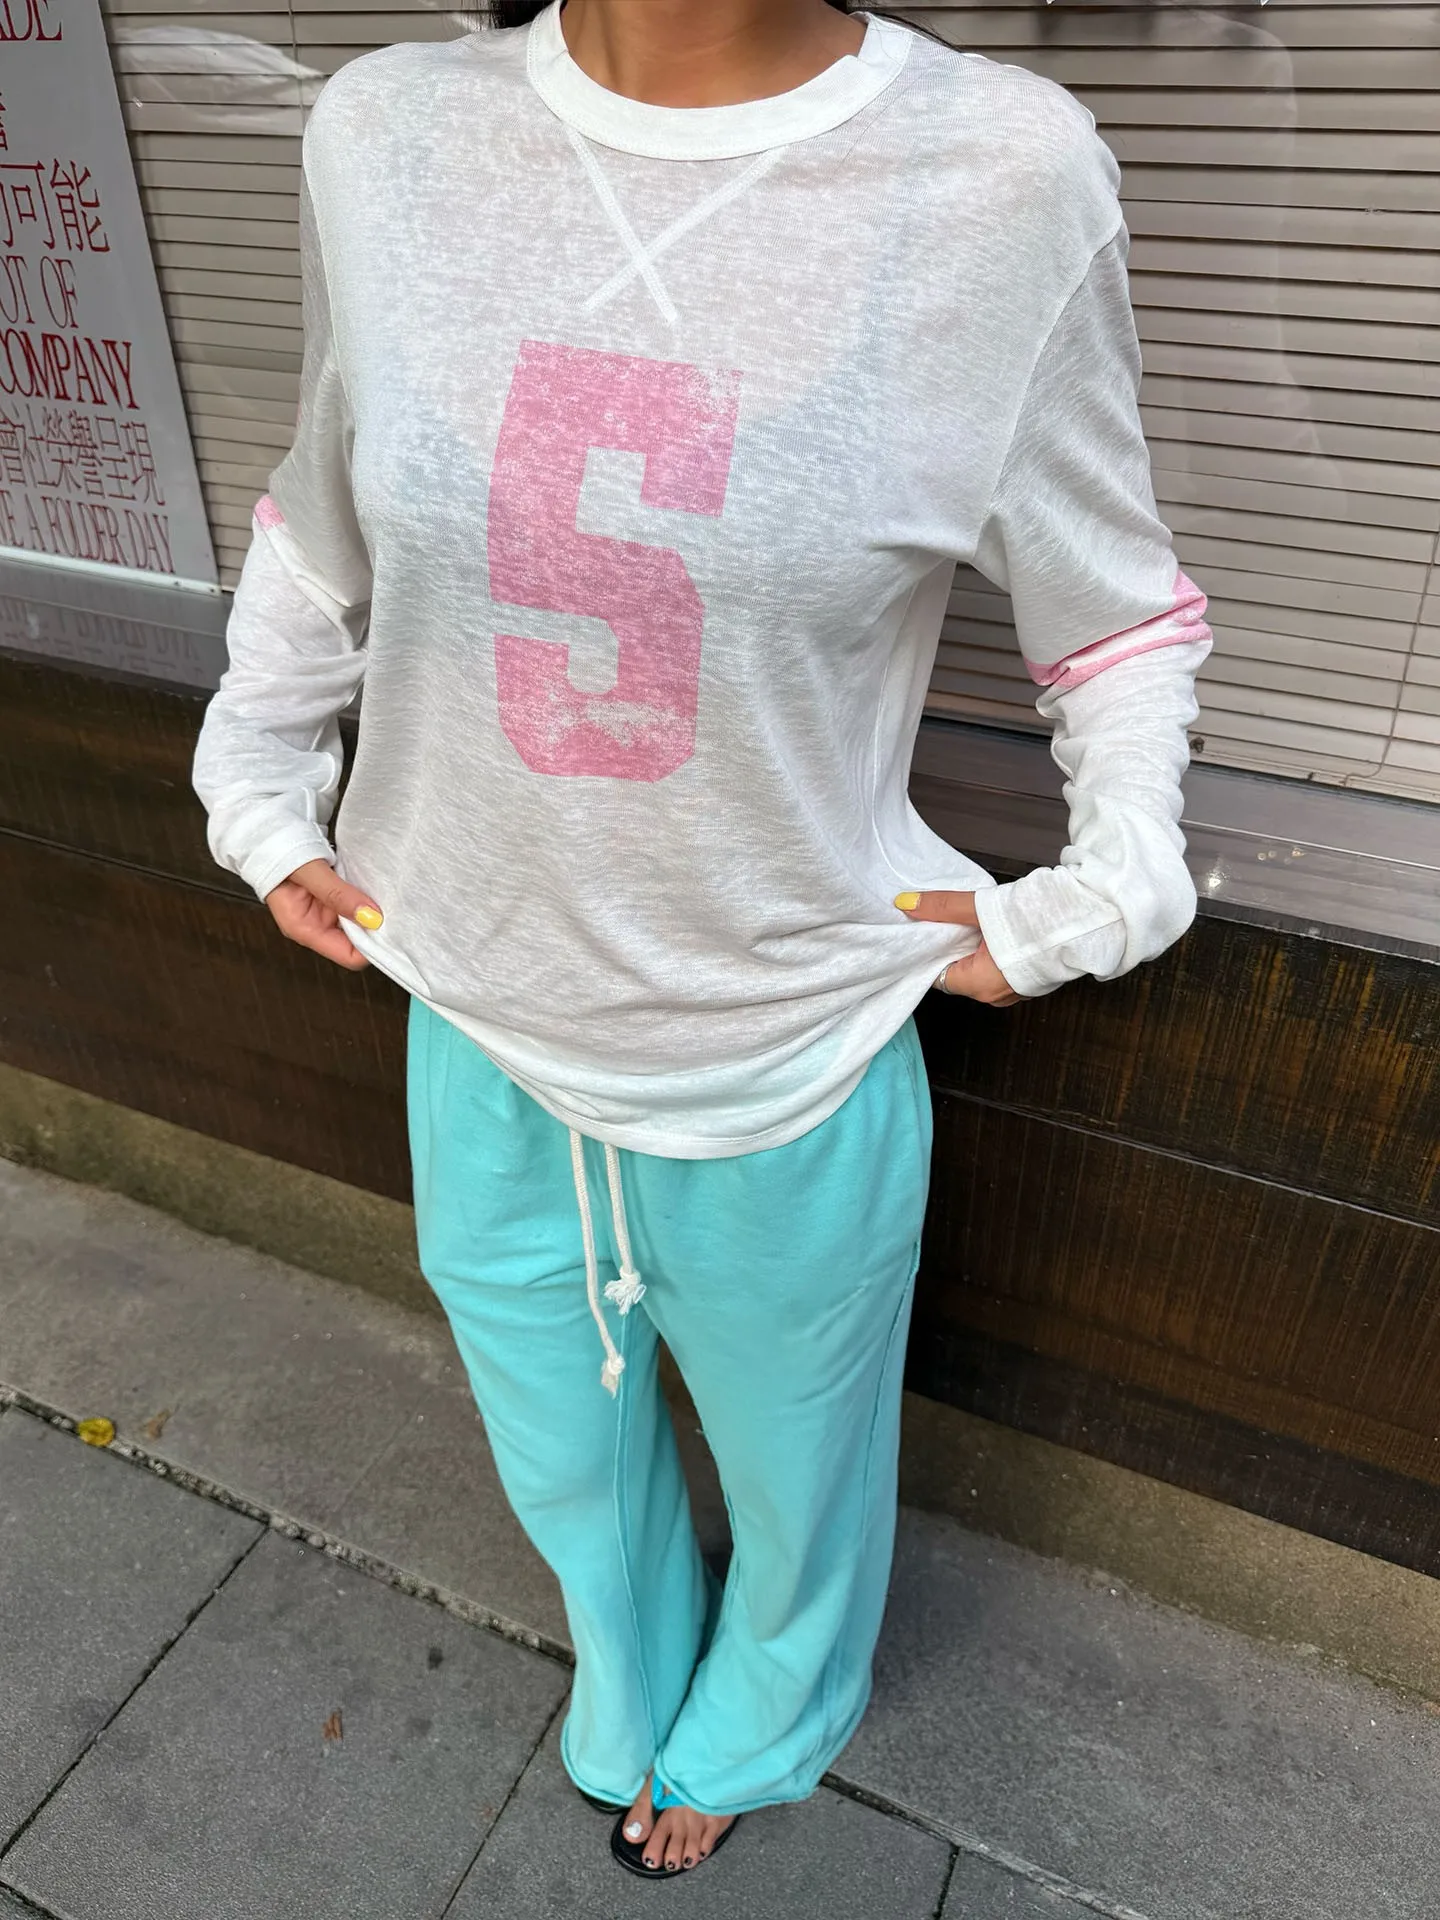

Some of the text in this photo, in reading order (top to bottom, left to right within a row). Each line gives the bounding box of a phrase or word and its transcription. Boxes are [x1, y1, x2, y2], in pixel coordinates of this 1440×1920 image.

[0, 157, 110, 253] 可能
[40, 256, 79, 329] OF
[25, 493, 46, 551] A
[124, 509, 175, 574] DAY
